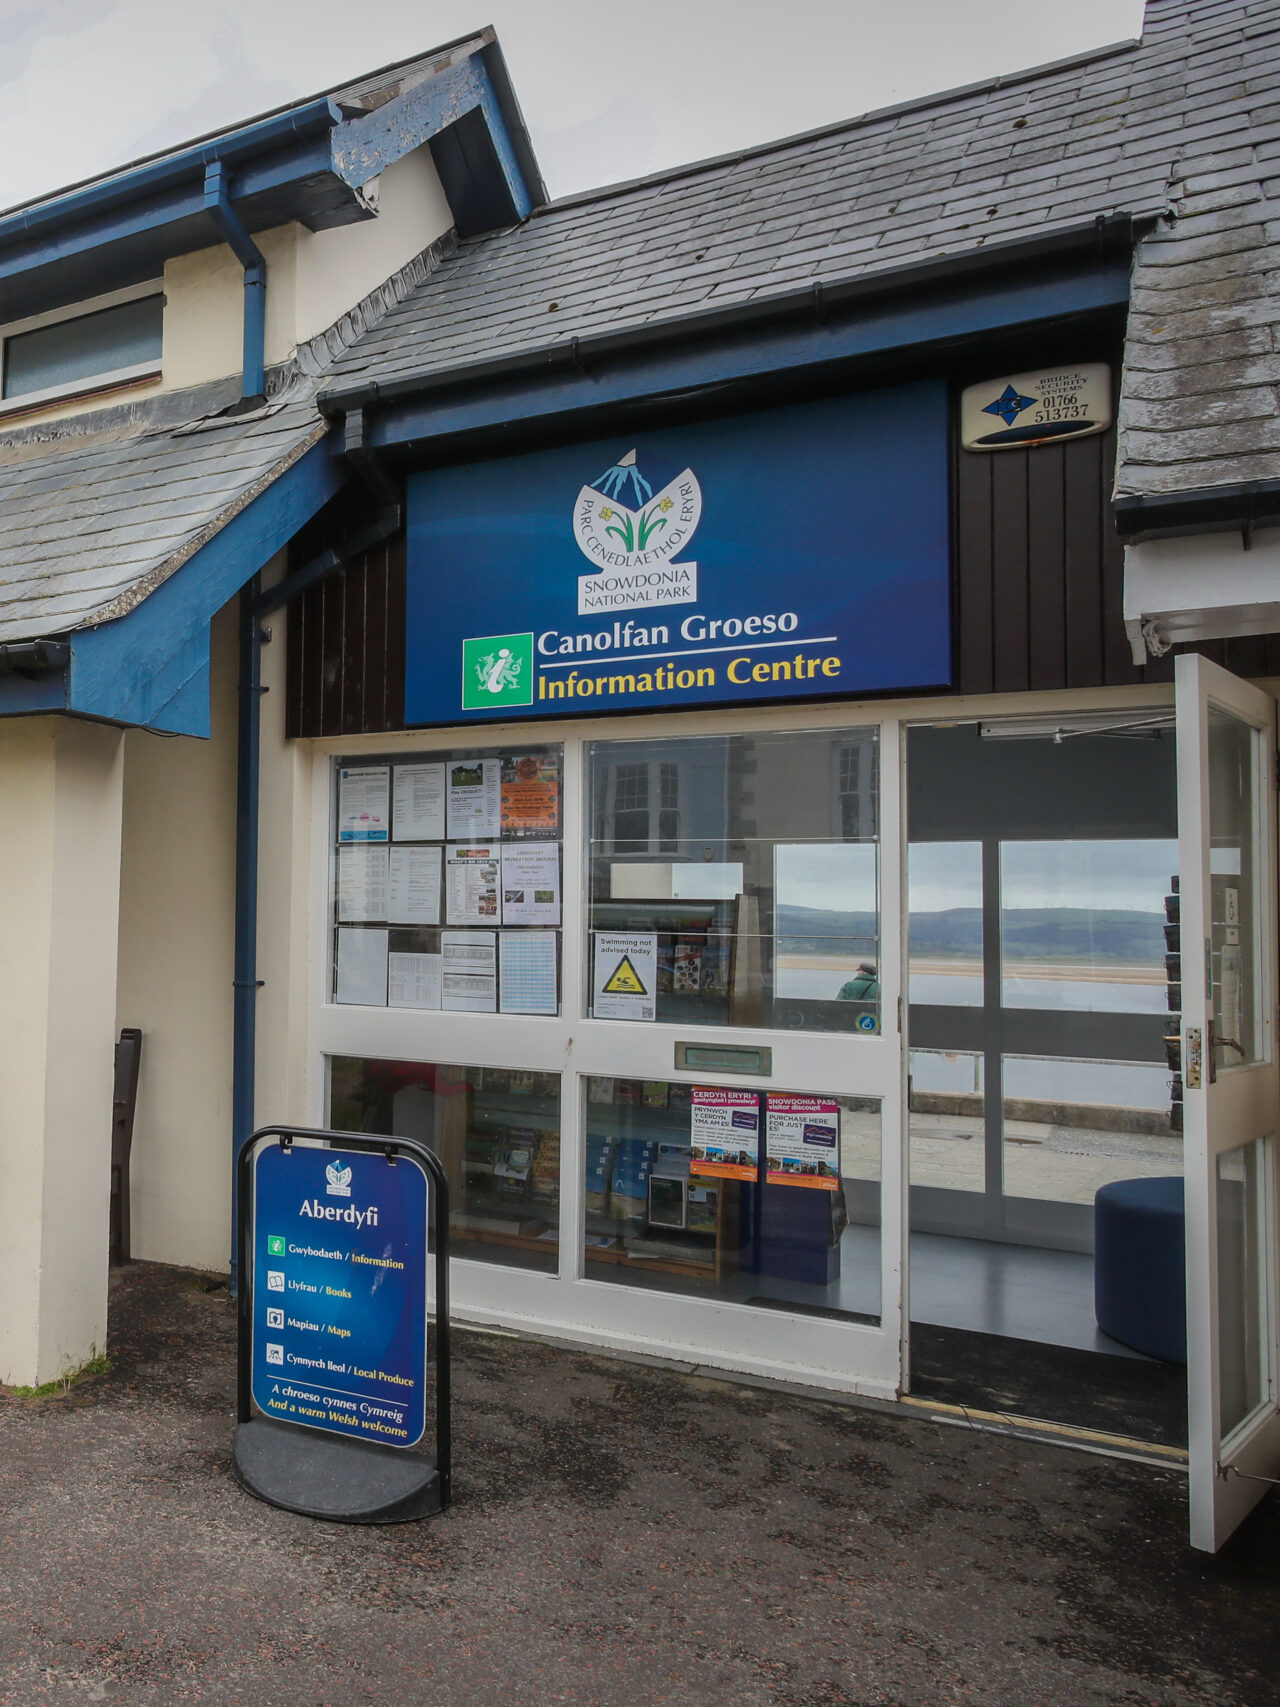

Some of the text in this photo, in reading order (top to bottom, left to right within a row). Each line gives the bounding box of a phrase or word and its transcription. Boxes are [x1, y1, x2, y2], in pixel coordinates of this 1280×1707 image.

[1035, 377, 1088, 390] SECURITY
[1039, 373, 1081, 385] BRIDGE
[1040, 385, 1083, 396] SYSTEMS
[1043, 393, 1078, 409] 01766
[1035, 404, 1089, 423] 513737
[580, 482, 694, 567] PARC CENEDLAETHOL ERYRI
[585, 569, 690, 594] SNOWDONIA
[585, 586, 691, 608] NATIONAL PARK
[538, 611, 798, 656] Canolfan Groeso
[538, 654, 841, 700] Information Centre
[601, 938, 637, 946] Swimming
[694, 1106, 728, 1115] PRYNWCH
[768, 1114, 807, 1123] PURCHASE
[299, 1199, 378, 1230] Aberdyfi
[288, 1243, 343, 1261] Gwybodaeth
[352, 1254, 404, 1270] Information
[288, 1280, 317, 1294] Llyfrau
[326, 1286, 352, 1299] Books
[287, 1318, 319, 1332] Mapiau
[327, 1325, 351, 1339] Maps
[287, 1353, 325, 1370] Cynnyrch
[327, 1361, 346, 1373] lleol
[353, 1366, 376, 1380] Local
[379, 1371, 414, 1387] Produce
[272, 1384, 403, 1424] A chroeso cynnes Cymreig
[267, 1398, 408, 1438] And a warm Welsh welcome
